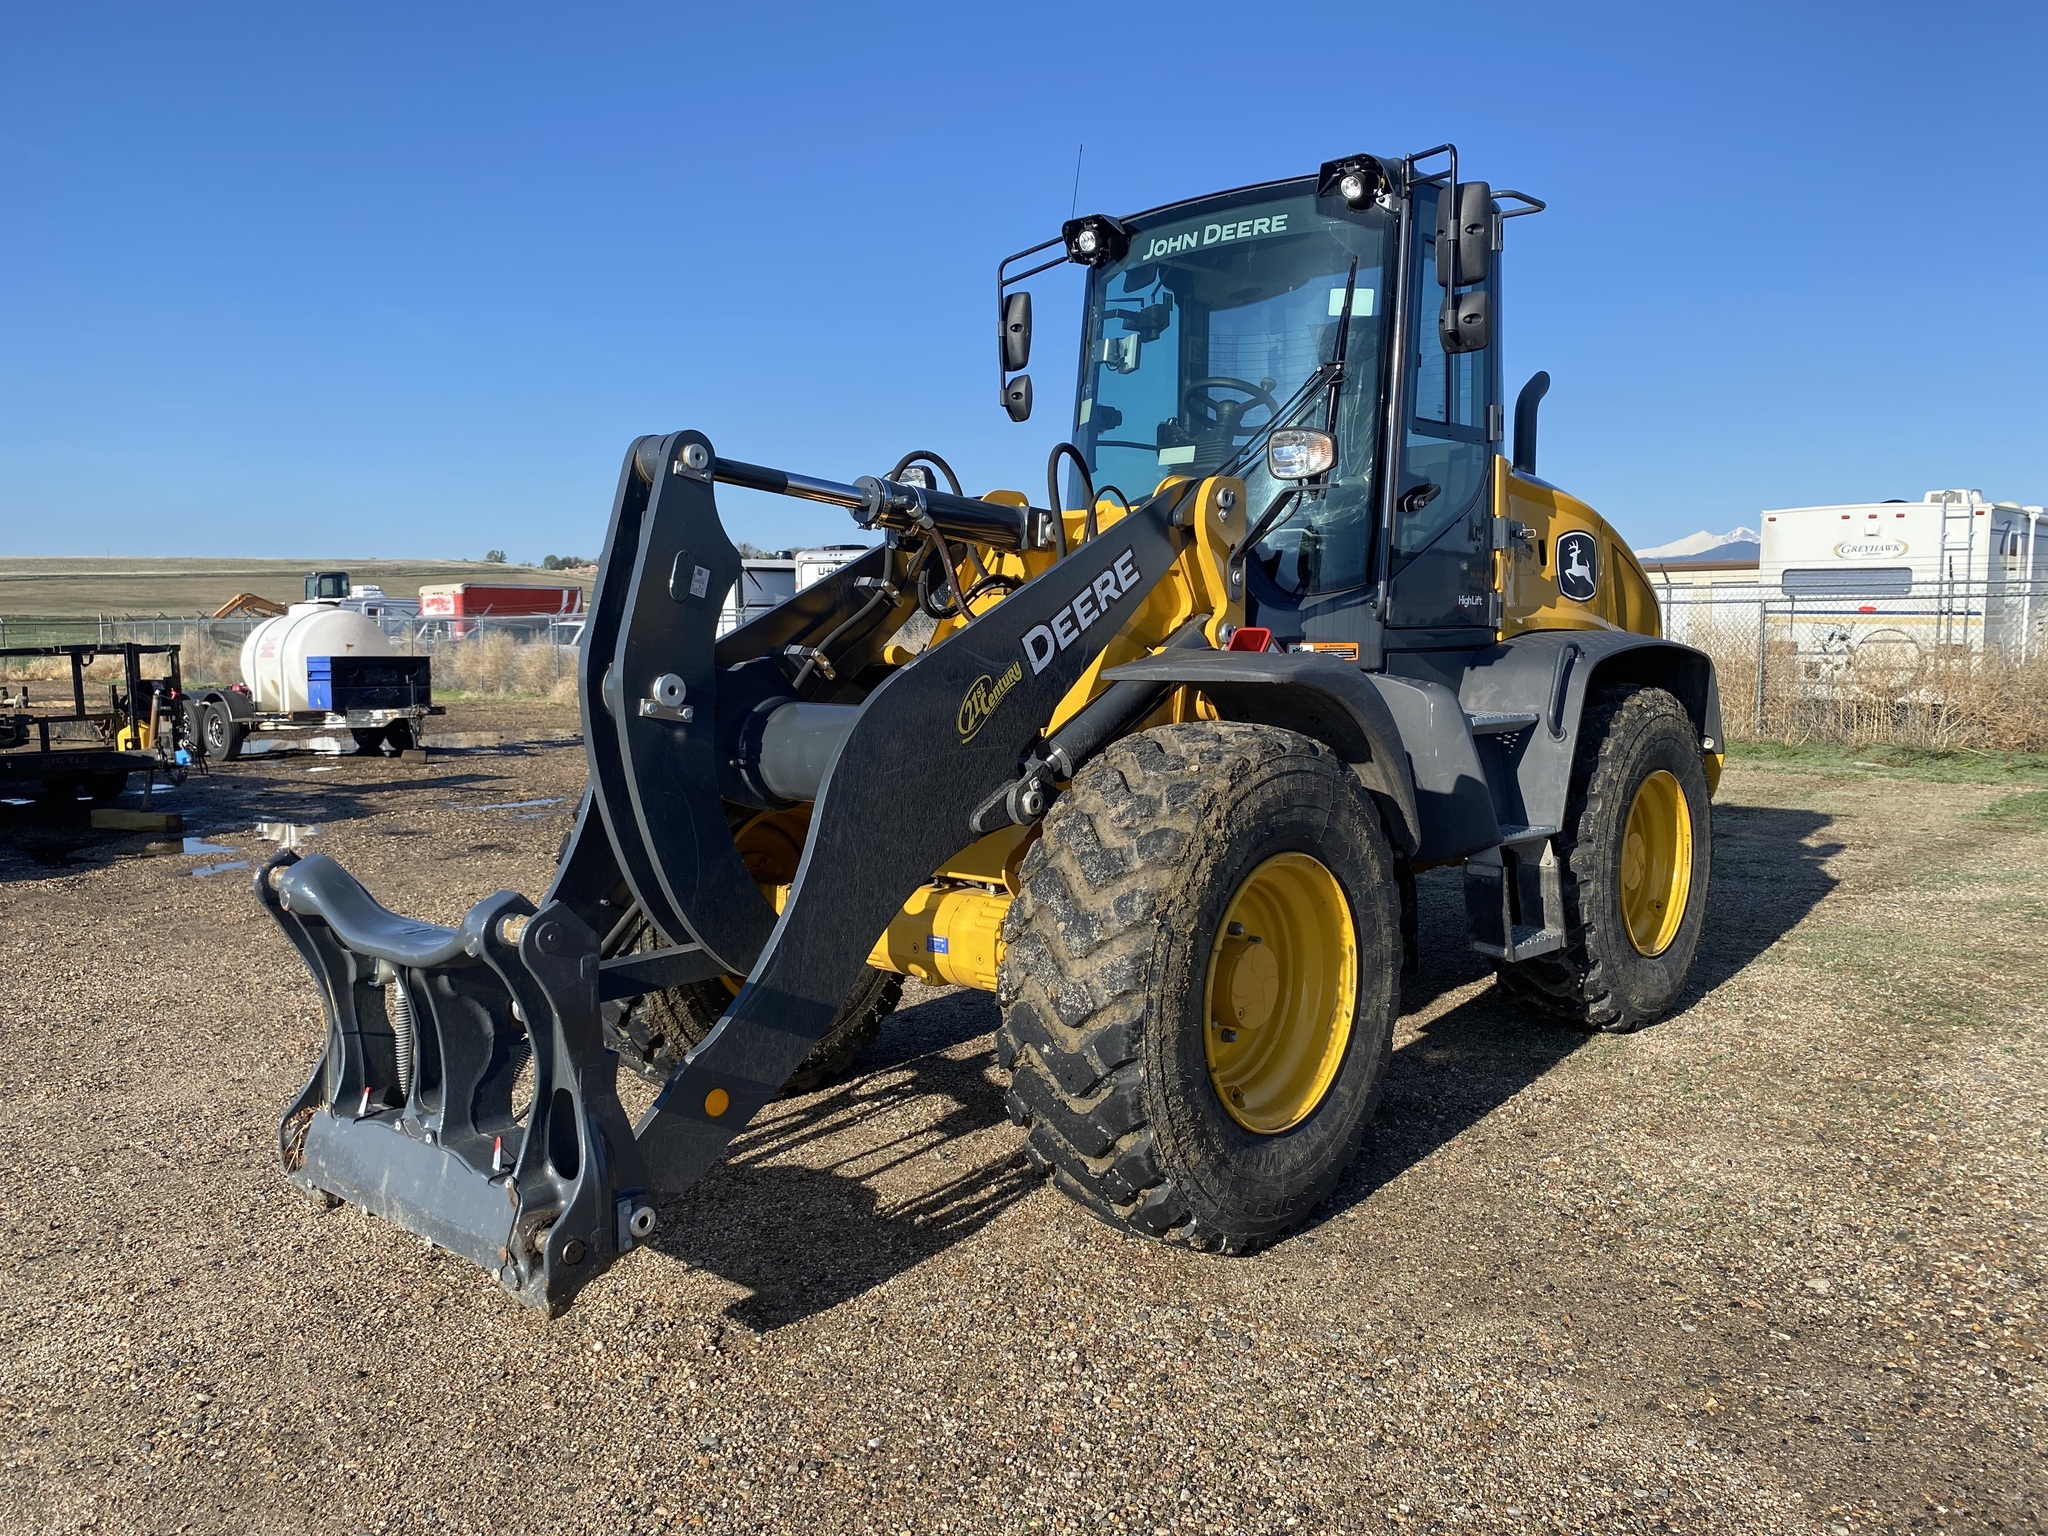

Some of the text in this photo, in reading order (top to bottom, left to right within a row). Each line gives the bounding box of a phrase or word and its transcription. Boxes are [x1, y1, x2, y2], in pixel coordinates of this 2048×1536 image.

[1142, 214, 1288, 260] JOHN DEERE
[1841, 544, 1900, 554] GREYHAWK
[1021, 549, 1140, 675] DEERE
[964, 682, 985, 731] 21st
